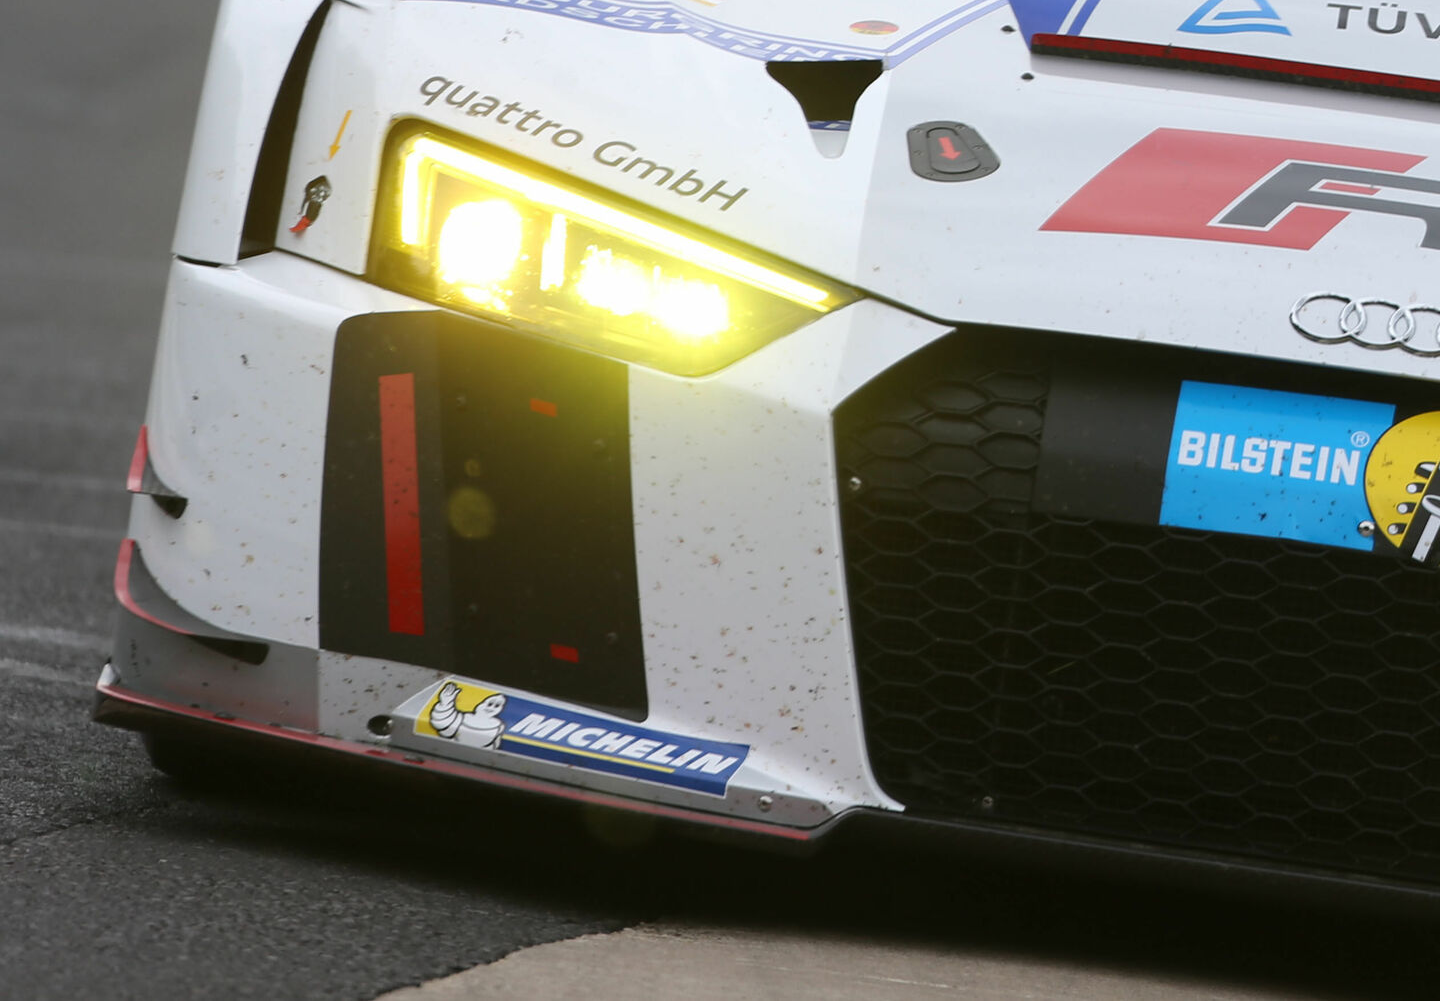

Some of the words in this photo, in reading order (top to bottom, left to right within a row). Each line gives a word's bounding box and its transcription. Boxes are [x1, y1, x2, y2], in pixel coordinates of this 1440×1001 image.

[420, 75, 584, 149] quattro
[593, 140, 750, 212] GmbH
[1177, 429, 1361, 486] BILSTEIN
[509, 713, 740, 776] MICHELIN
